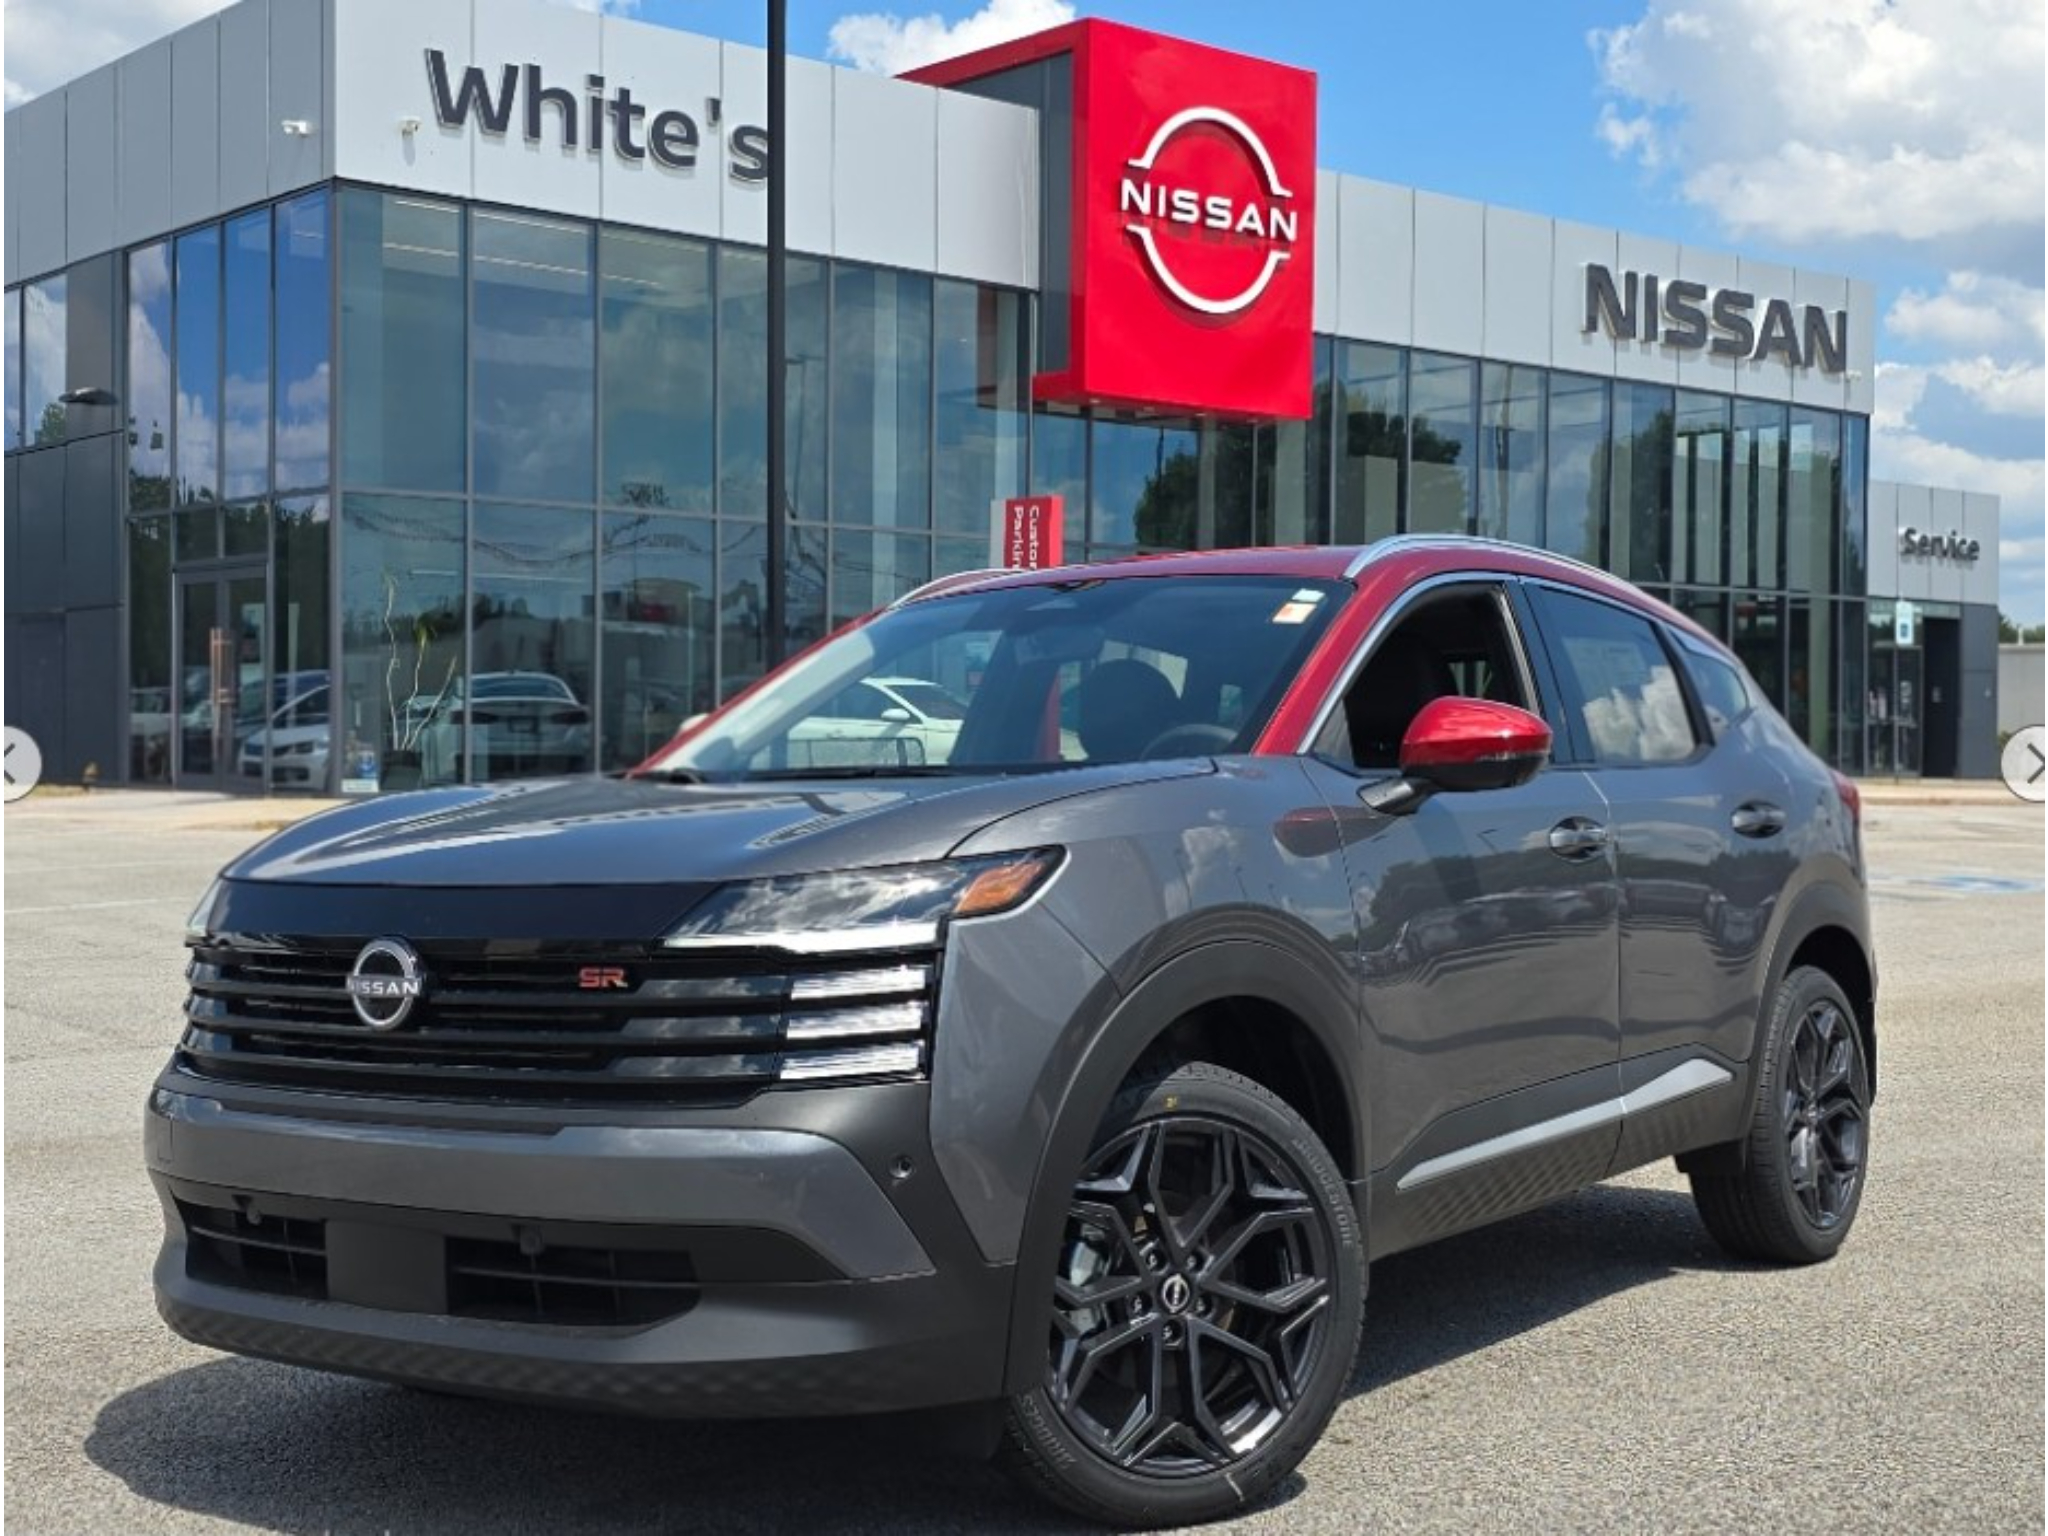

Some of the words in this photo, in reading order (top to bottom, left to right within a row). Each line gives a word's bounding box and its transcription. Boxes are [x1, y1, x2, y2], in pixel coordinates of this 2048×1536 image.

[424, 48, 767, 182] White's
[1121, 178, 1297, 241] NISSAN
[1580, 262, 1847, 372] NISSAN
[1899, 527, 1980, 561] Service
[579, 967, 628, 988] SR
